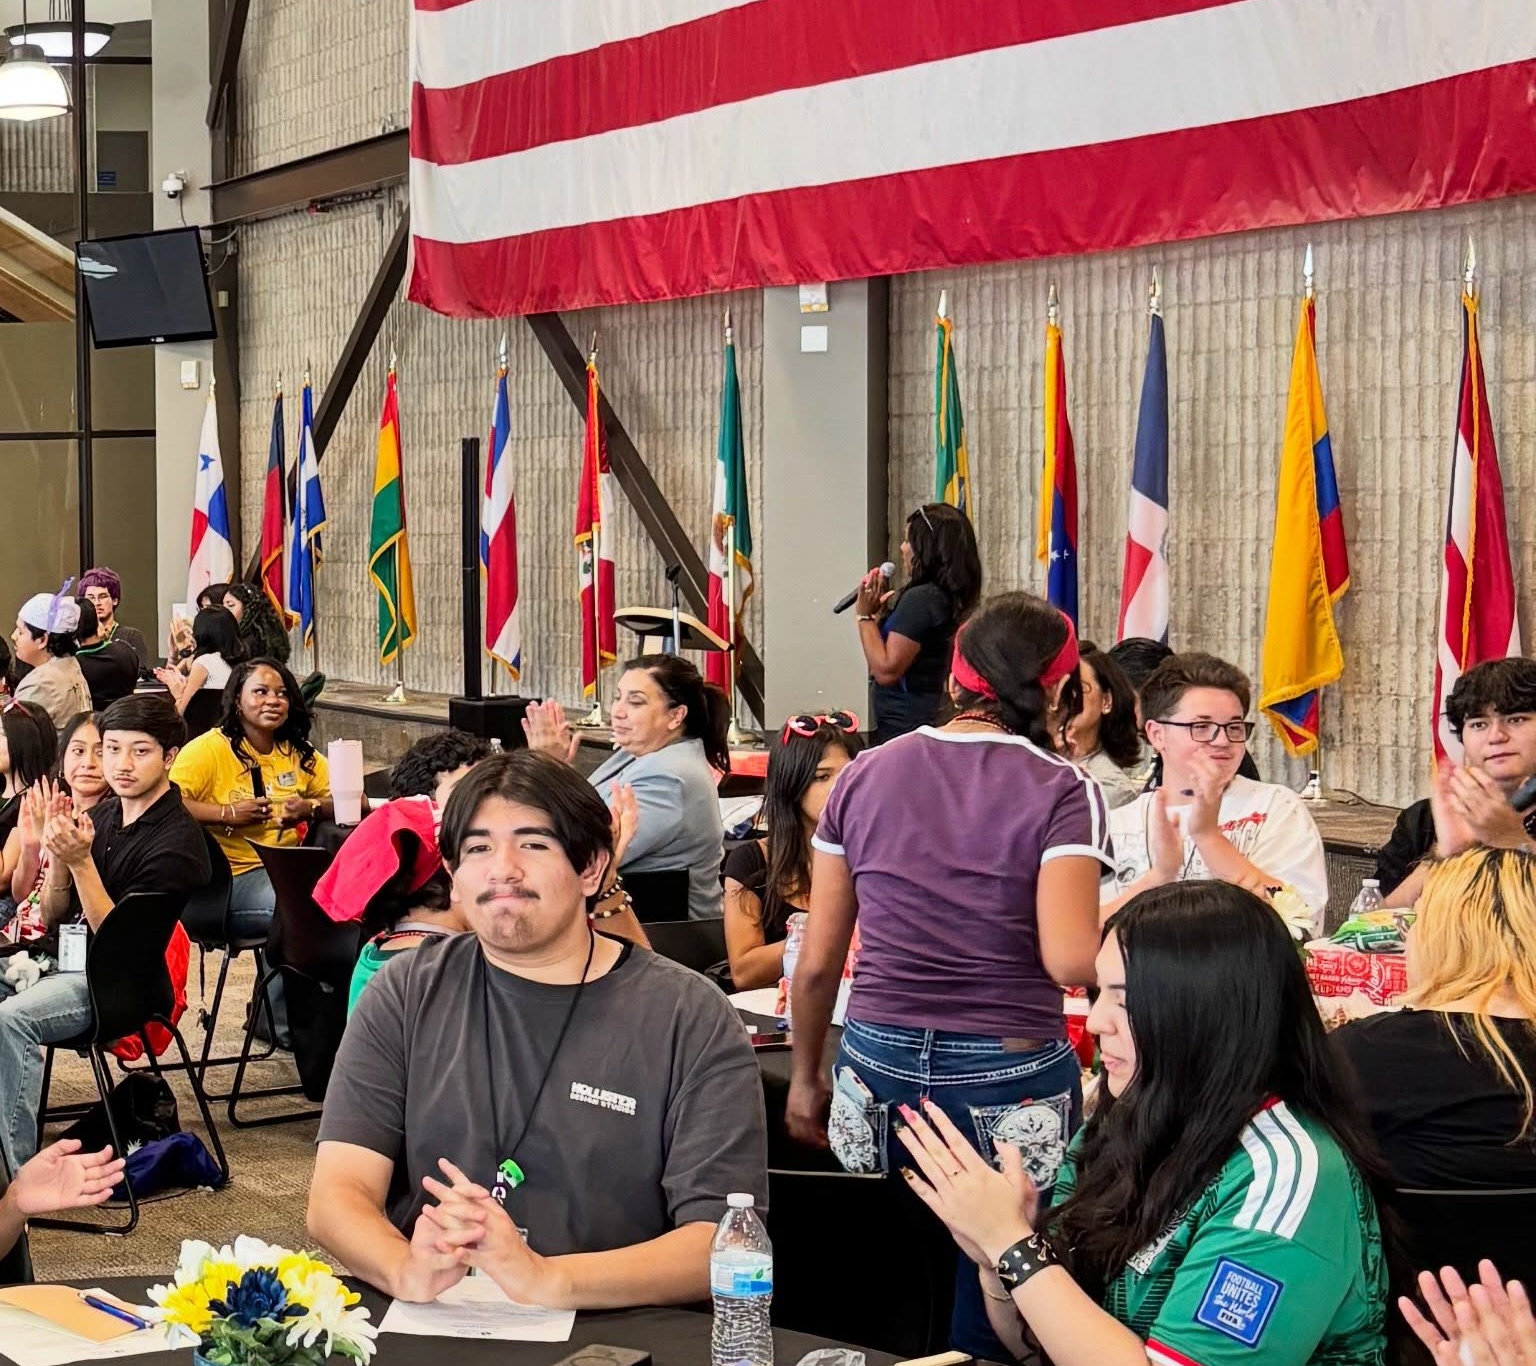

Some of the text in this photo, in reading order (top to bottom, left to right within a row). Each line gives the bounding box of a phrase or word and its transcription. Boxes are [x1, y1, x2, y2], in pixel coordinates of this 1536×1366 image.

[571, 1081, 637, 1110] HOLLISTER
[1221, 1281, 1261, 1309] UNITES
[1226, 1271, 1264, 1296] FOOTBALL
[1221, 1312, 1239, 1325] FIFA
